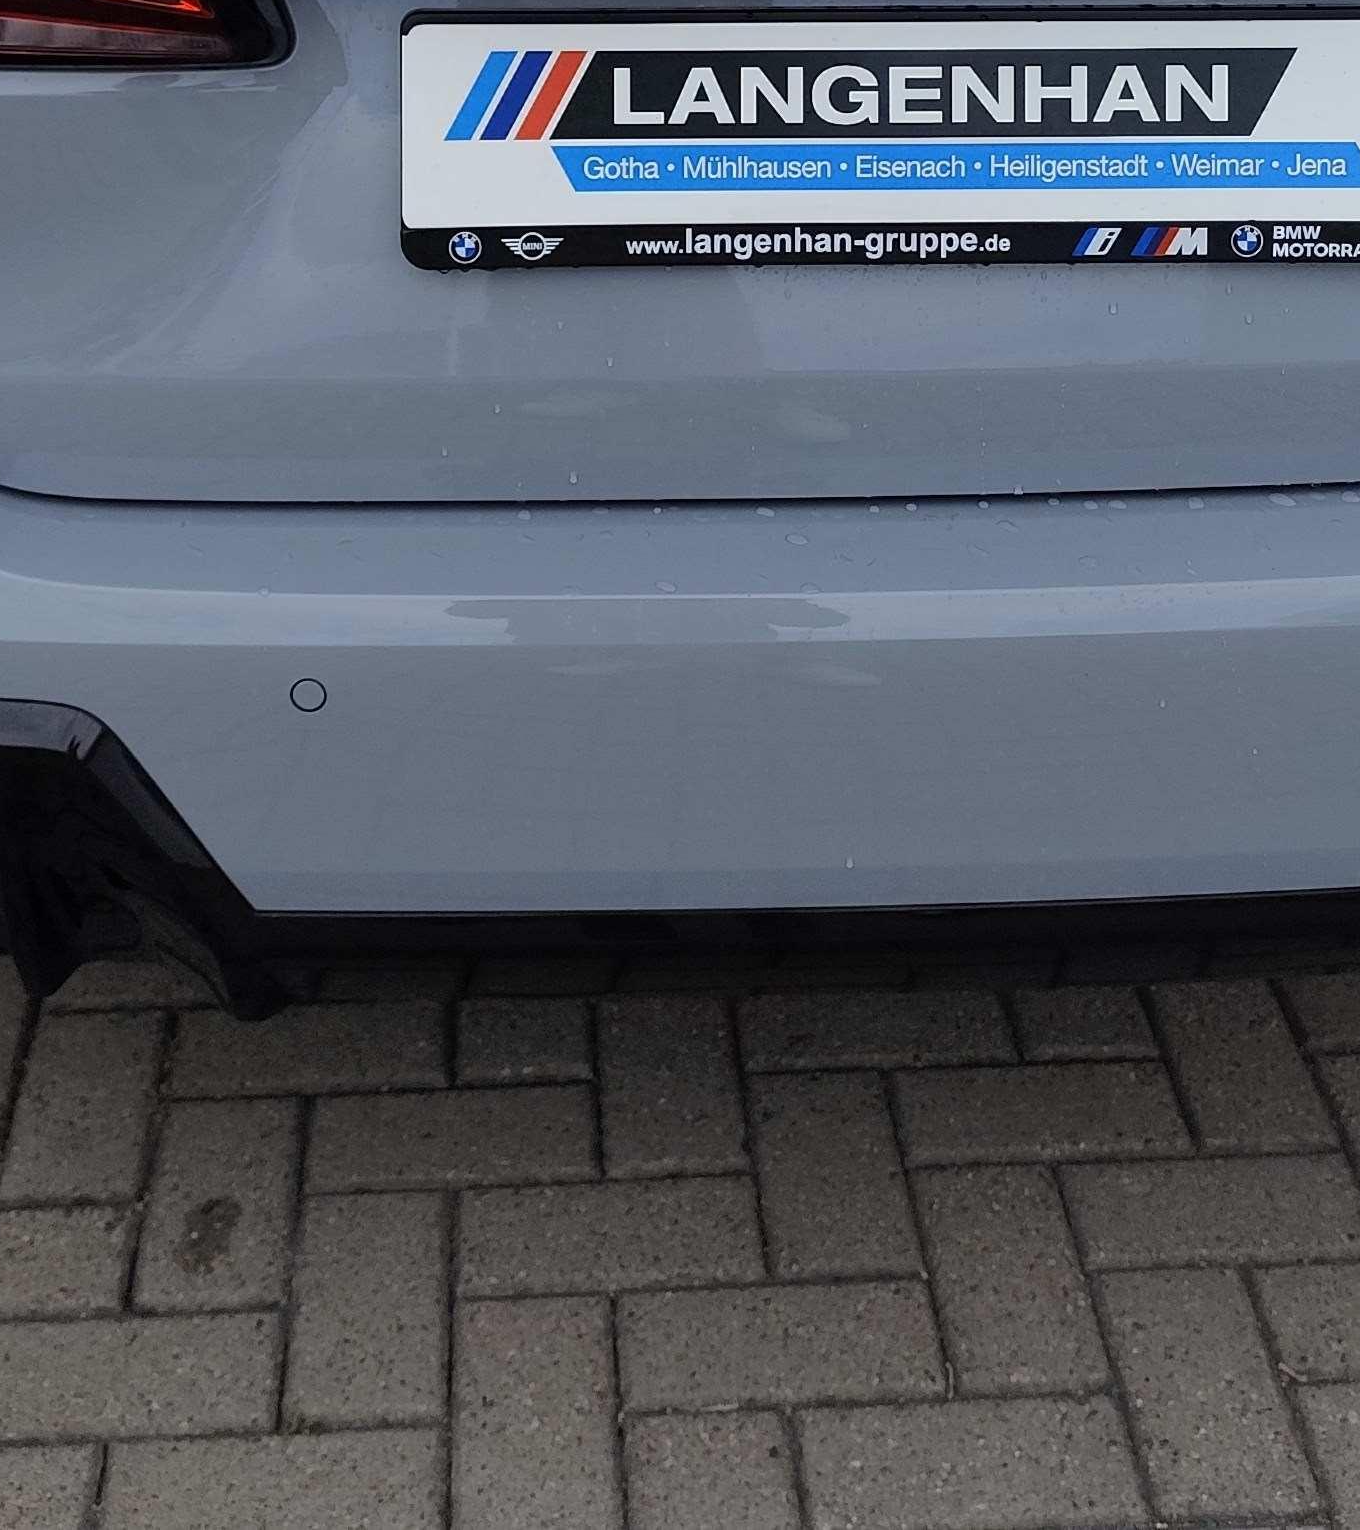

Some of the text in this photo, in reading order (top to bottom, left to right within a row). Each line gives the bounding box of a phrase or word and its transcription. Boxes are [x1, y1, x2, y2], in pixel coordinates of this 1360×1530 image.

[613, 65, 1229, 125] LANGENHAN
[583, 153, 1347, 182] Gotha Mühlhausen Eisenach Heiligenstadt Weimar Jena
[522, 242, 543, 251] MINI
[626, 227, 1010, 259] www.langenhan-gruppe.de
[1272, 225, 1321, 240] BMW
